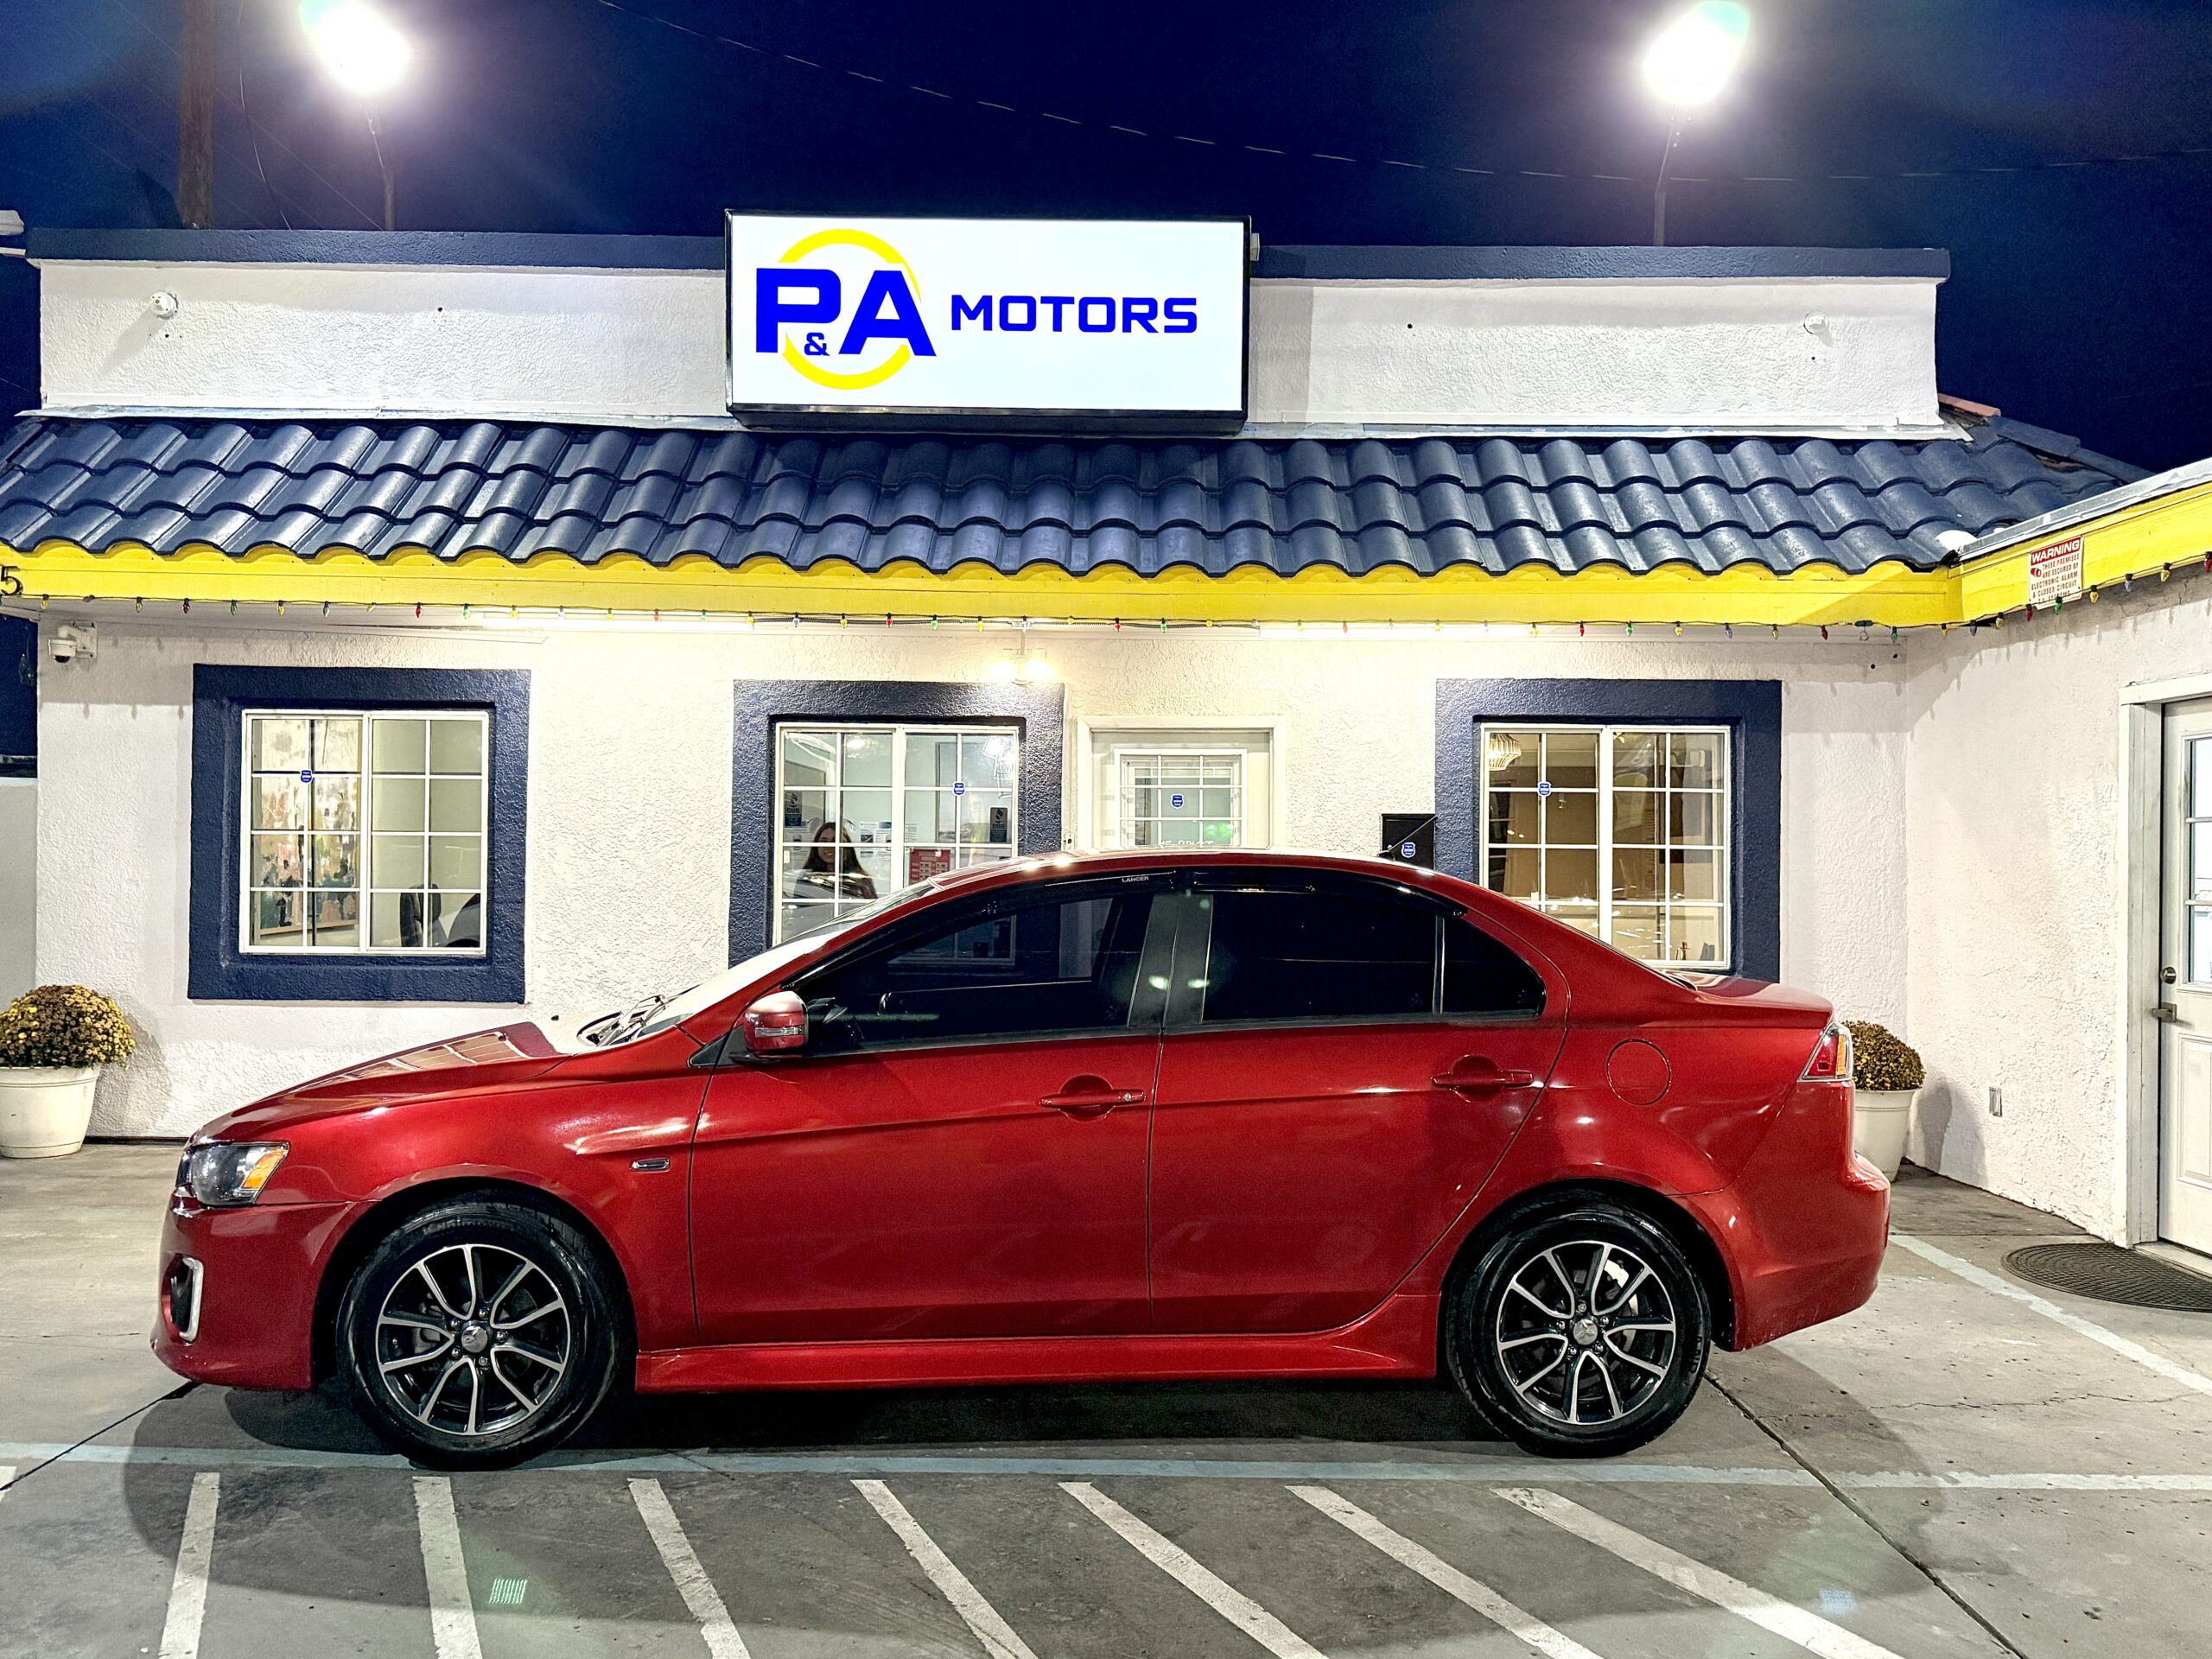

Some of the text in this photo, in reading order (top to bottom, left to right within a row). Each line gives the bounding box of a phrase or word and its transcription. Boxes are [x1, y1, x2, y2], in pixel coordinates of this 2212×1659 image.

[951, 295, 1198, 334] MOTORS
[2031, 540, 2080, 564] WARNING
[2043, 553, 2080, 570] THESE PREMISES
[2052, 563, 2072, 575] SECURED
[2031, 570, 2078, 591] ELECTRONIC ALARM
[2037, 586, 2056, 598] CLOSED
[2056, 580, 2077, 592] CIRCUIT
